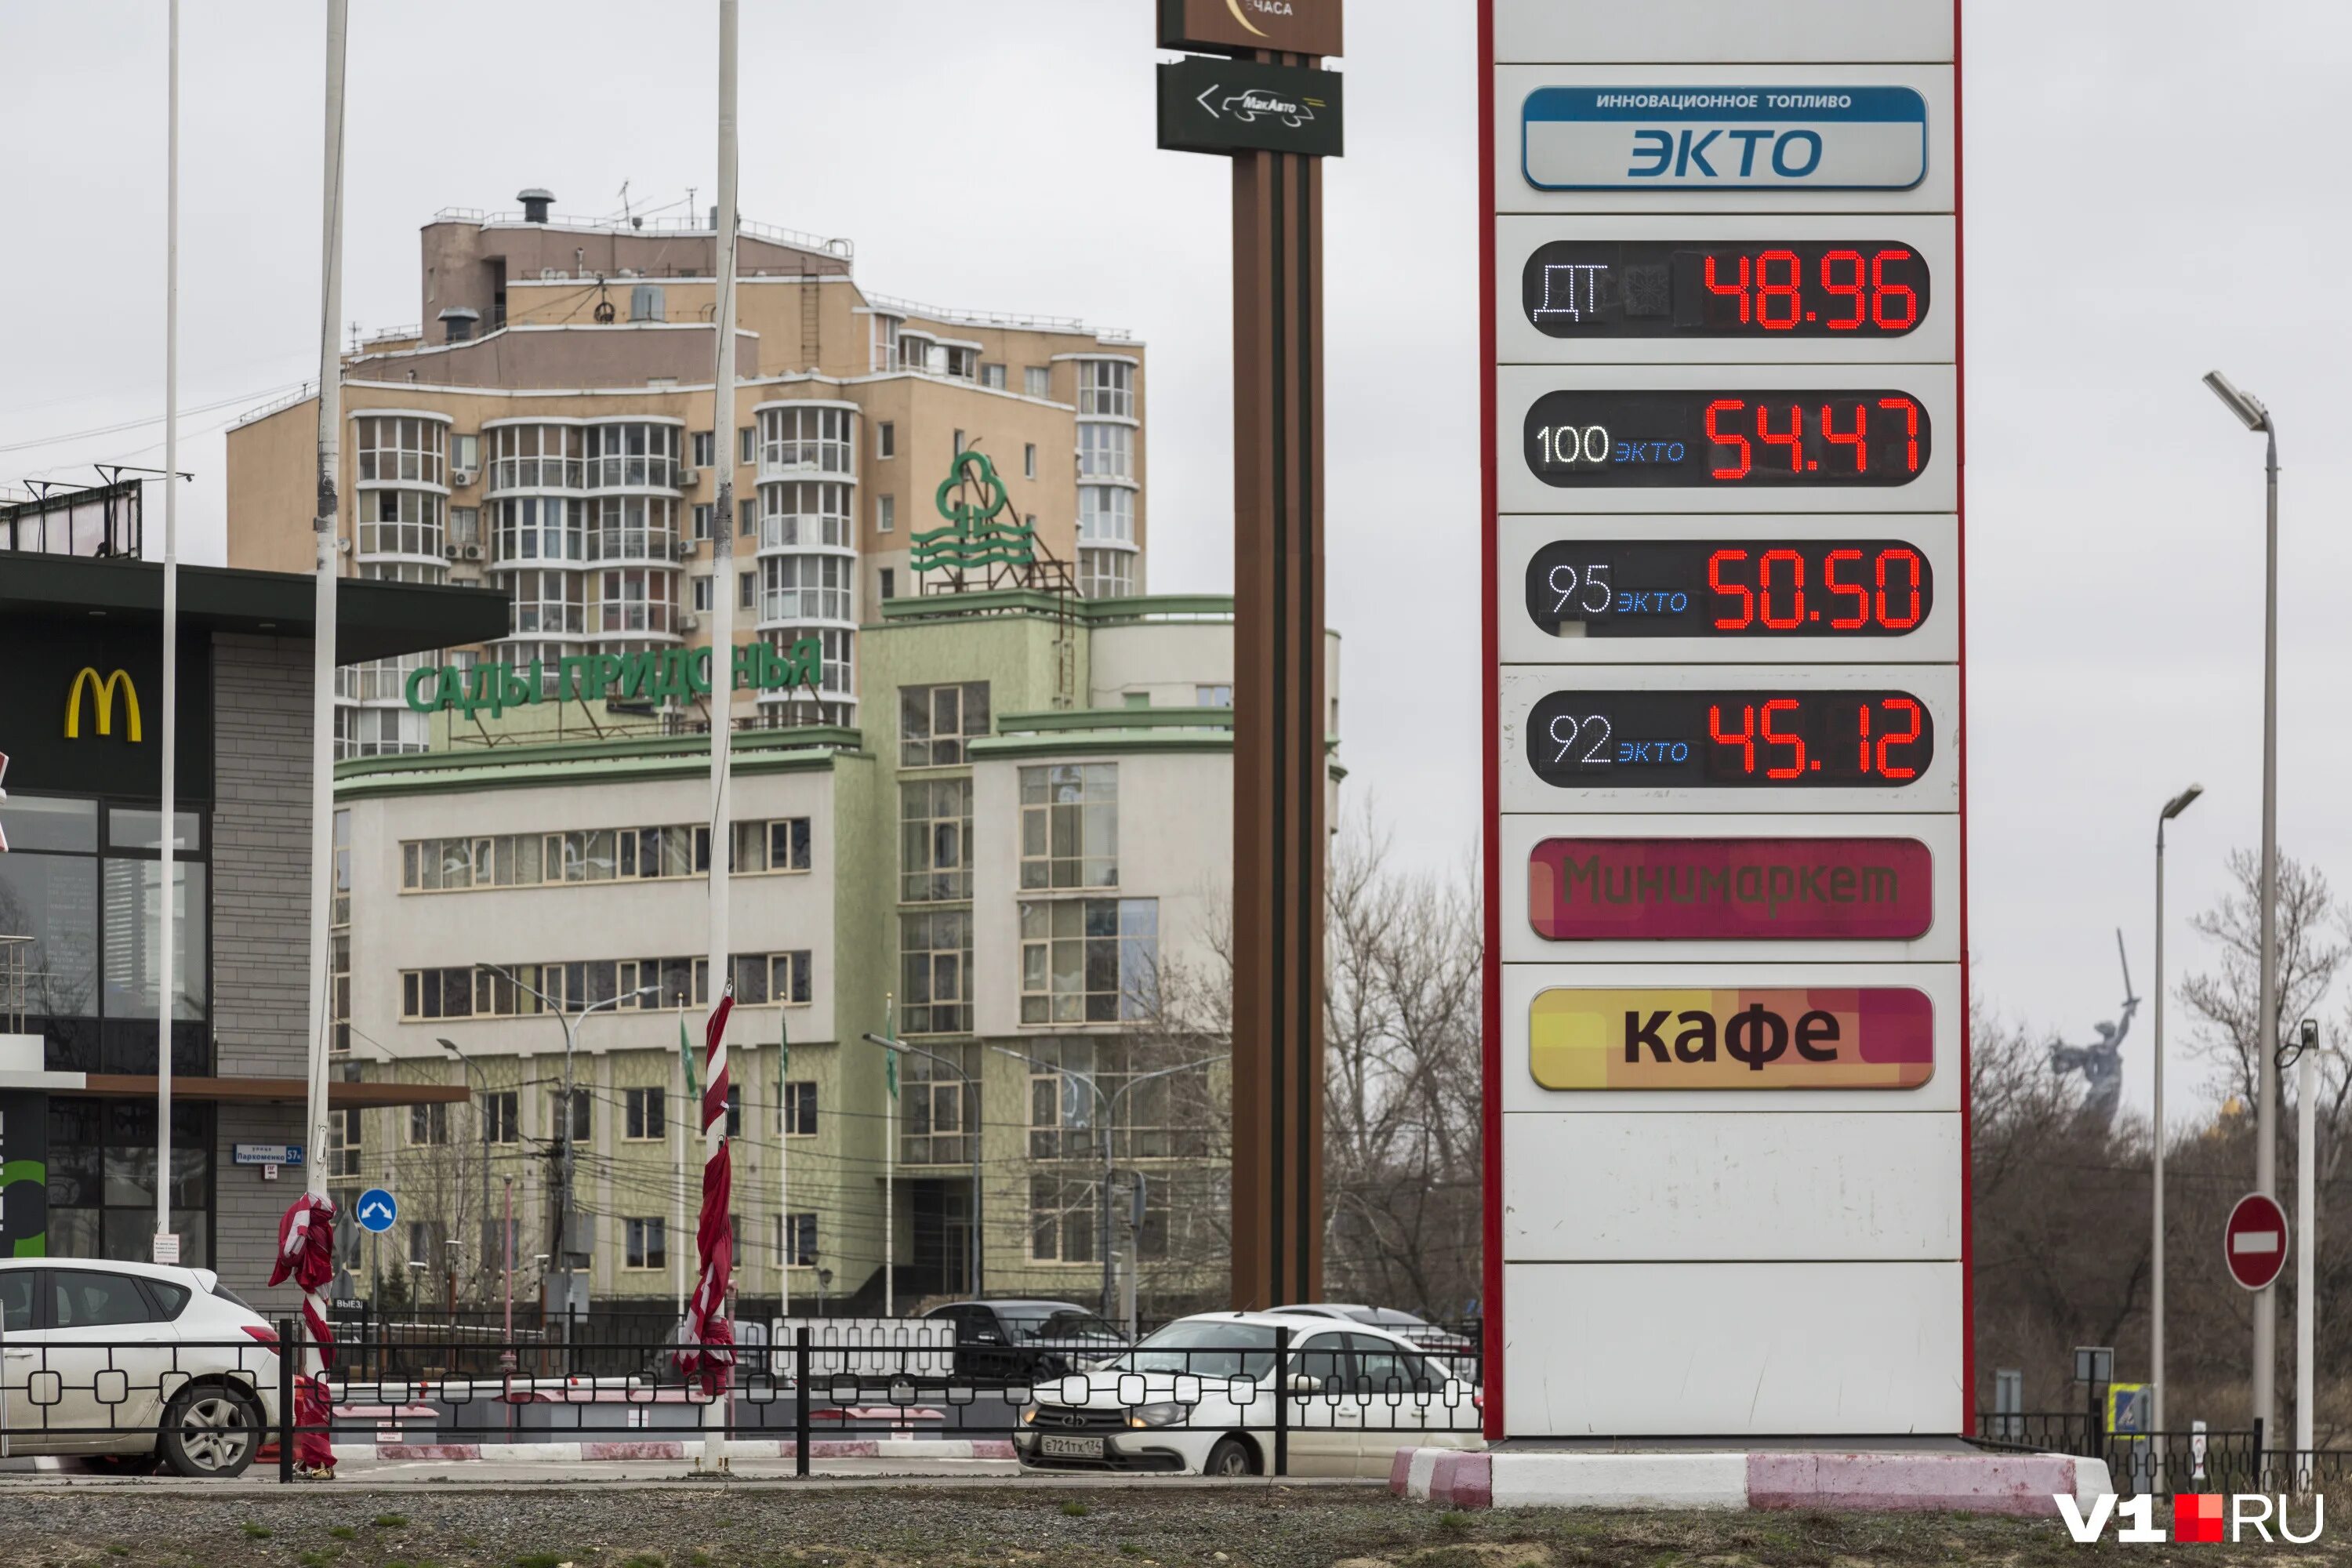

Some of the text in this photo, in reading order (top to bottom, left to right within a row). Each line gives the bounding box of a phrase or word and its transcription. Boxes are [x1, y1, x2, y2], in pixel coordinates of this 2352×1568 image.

[1254, 0, 1293, 16] ЧАСА
[1596, 94, 1851, 110] ИННОВАЦИОННОЕ ТОПЛИВО
[1628, 129, 1823, 177] ЭКТО
[1534, 249, 1917, 330] ДТ 48.96
[1537, 397, 1918, 479] 100 ЭКТО 54.47
[1548, 548, 1921, 630] 95 ЭКТО 50.50
[405, 659, 543, 720] САДЫ
[1549, 699, 1922, 779] 92 ЭКТО 45.12
[1563, 855, 1899, 920] Минимаркет
[1624, 1003, 1841, 1072] кафе
[238, 1152, 285, 1162] Пархоменко
